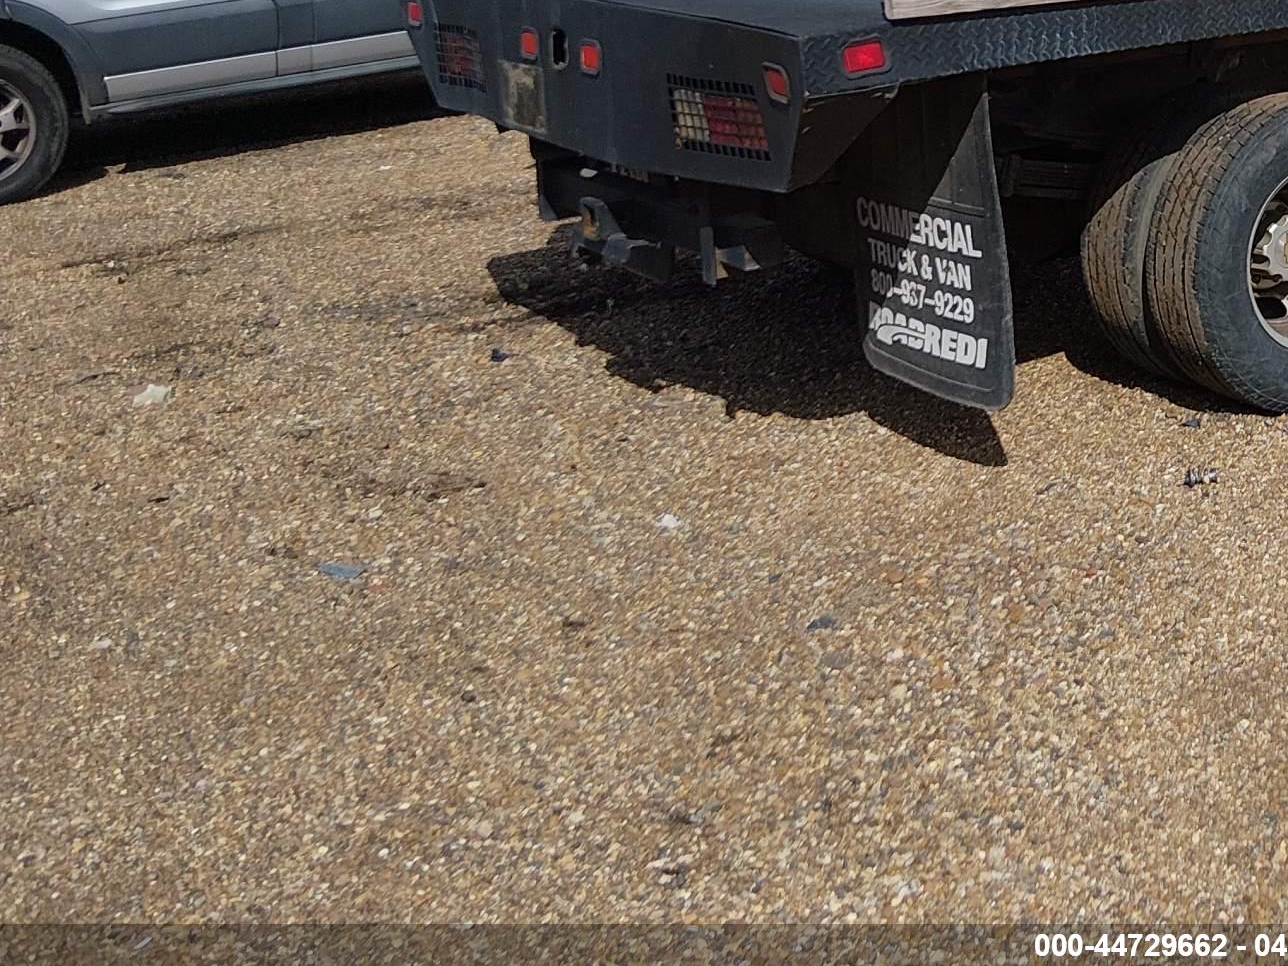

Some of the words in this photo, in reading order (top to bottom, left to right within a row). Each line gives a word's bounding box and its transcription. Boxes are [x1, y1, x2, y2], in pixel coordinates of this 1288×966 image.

[856, 197, 982, 258] COMMERCIAL
[867, 237, 918, 276] TRUCK
[920, 254, 933, 281] &
[935, 257, 972, 291] VAN
